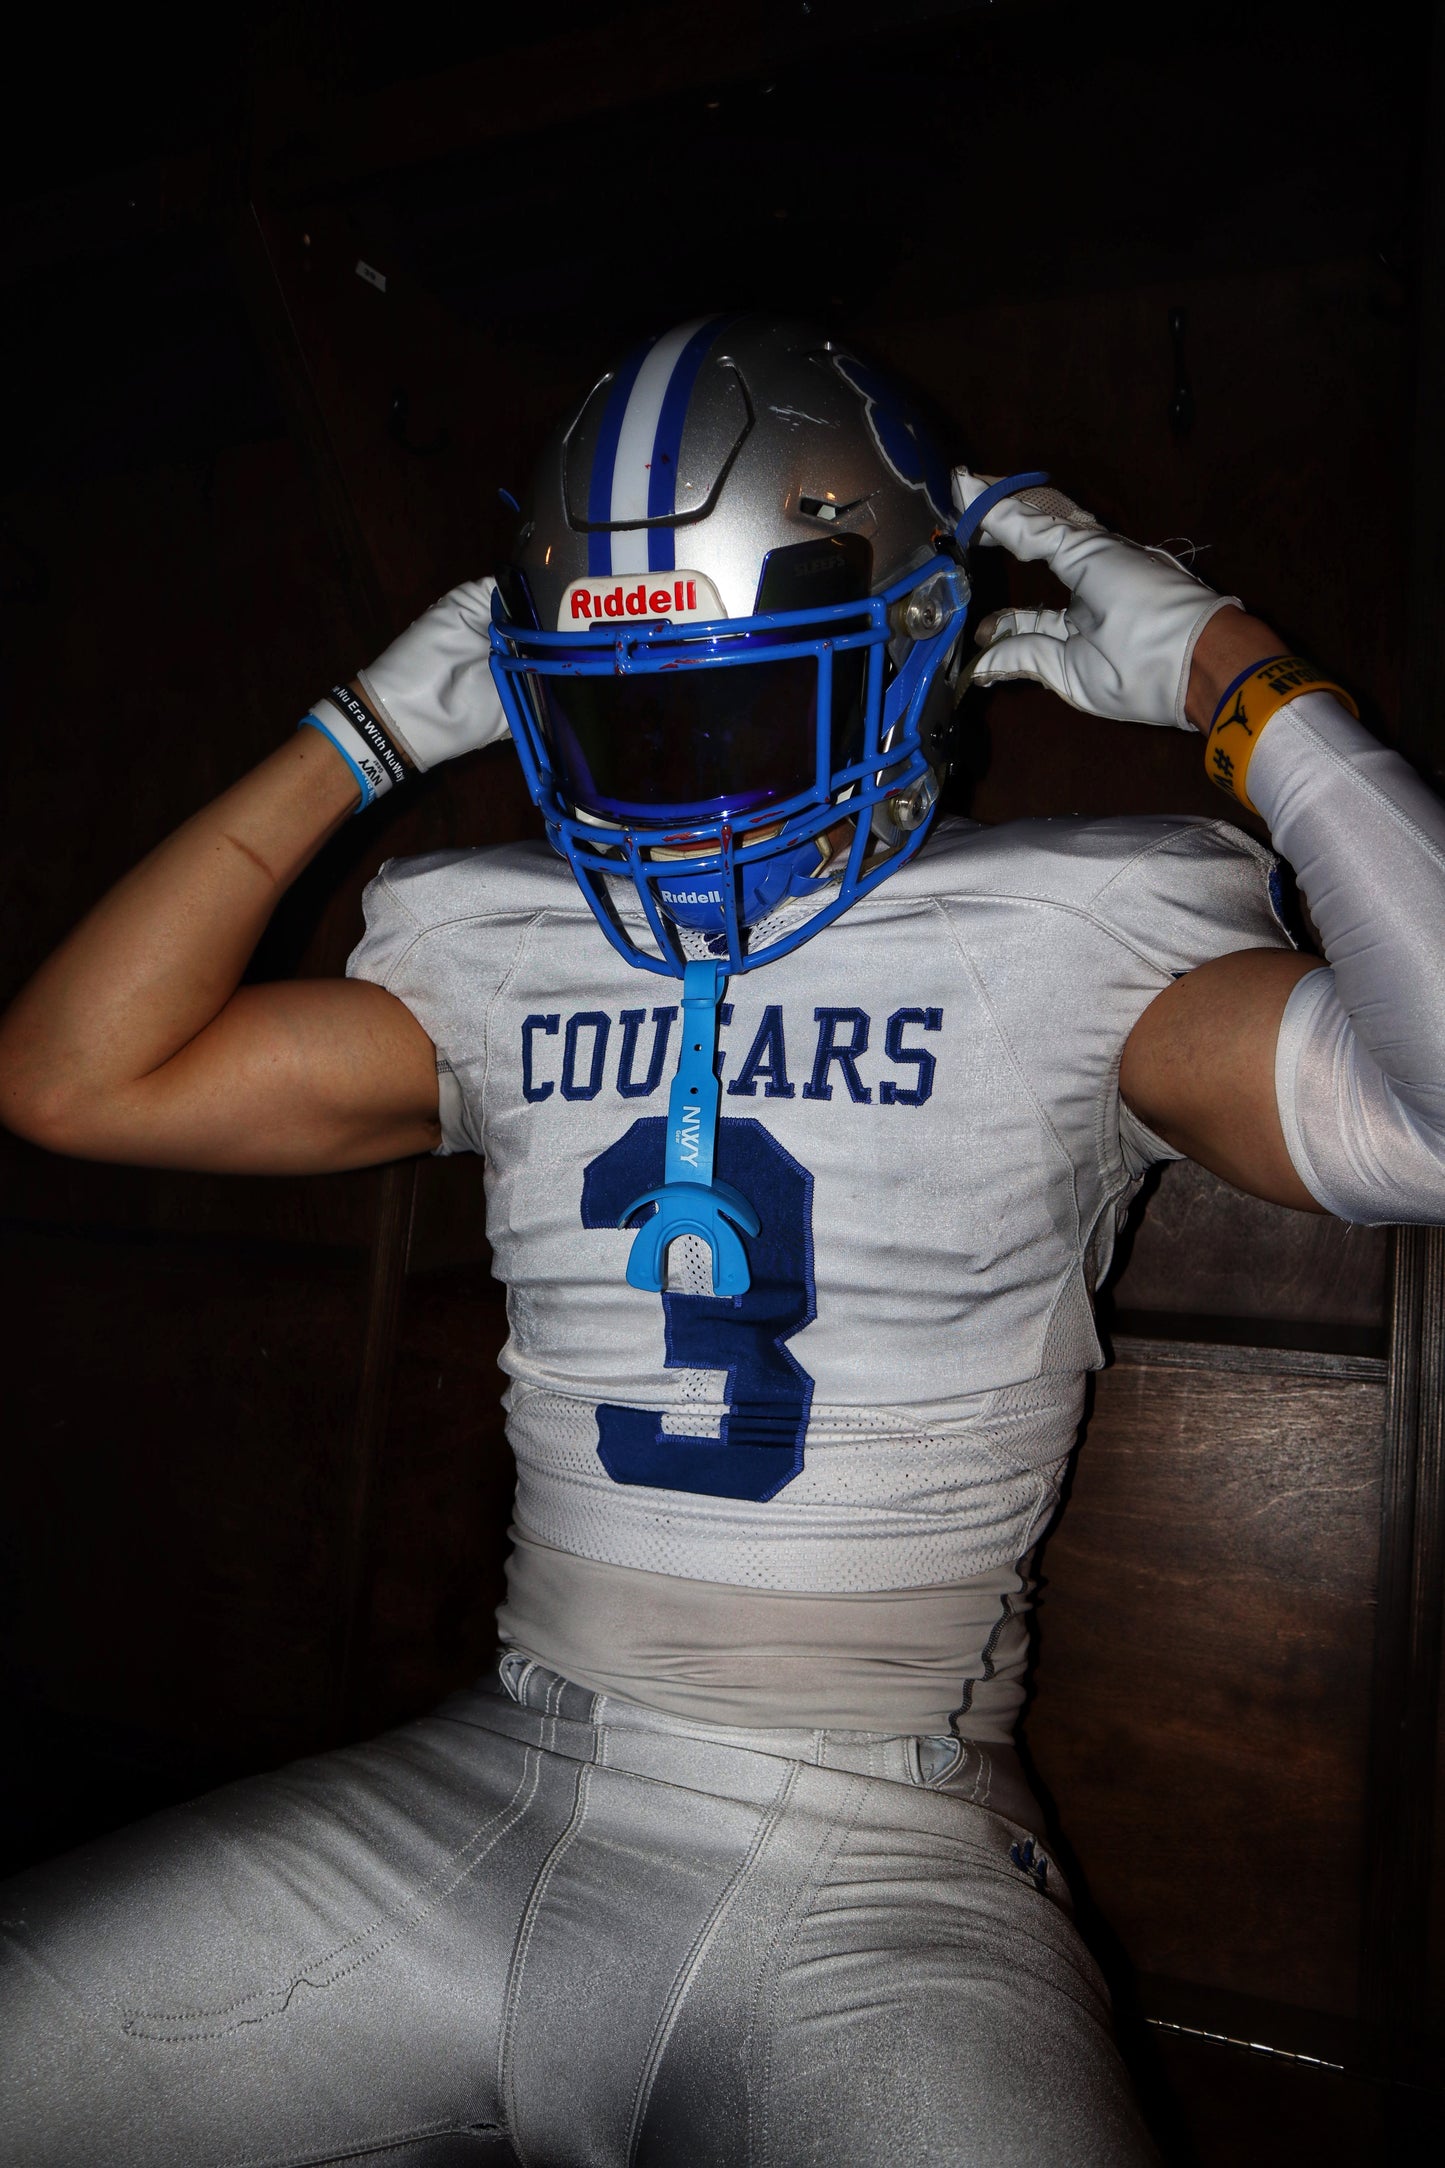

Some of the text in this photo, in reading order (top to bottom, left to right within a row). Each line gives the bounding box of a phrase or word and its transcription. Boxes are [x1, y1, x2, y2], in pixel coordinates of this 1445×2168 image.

[570, 579, 697, 619] Riddell
[348, 700, 366, 723] Era
[364, 720, 386, 751] With
[358, 758, 383, 786] NWY
[661, 890, 721, 904] Riddell
[521, 1003, 944, 1107] COUARS
[680, 1105, 702, 1168] NWY
[580, 1116, 818, 1502] 3
